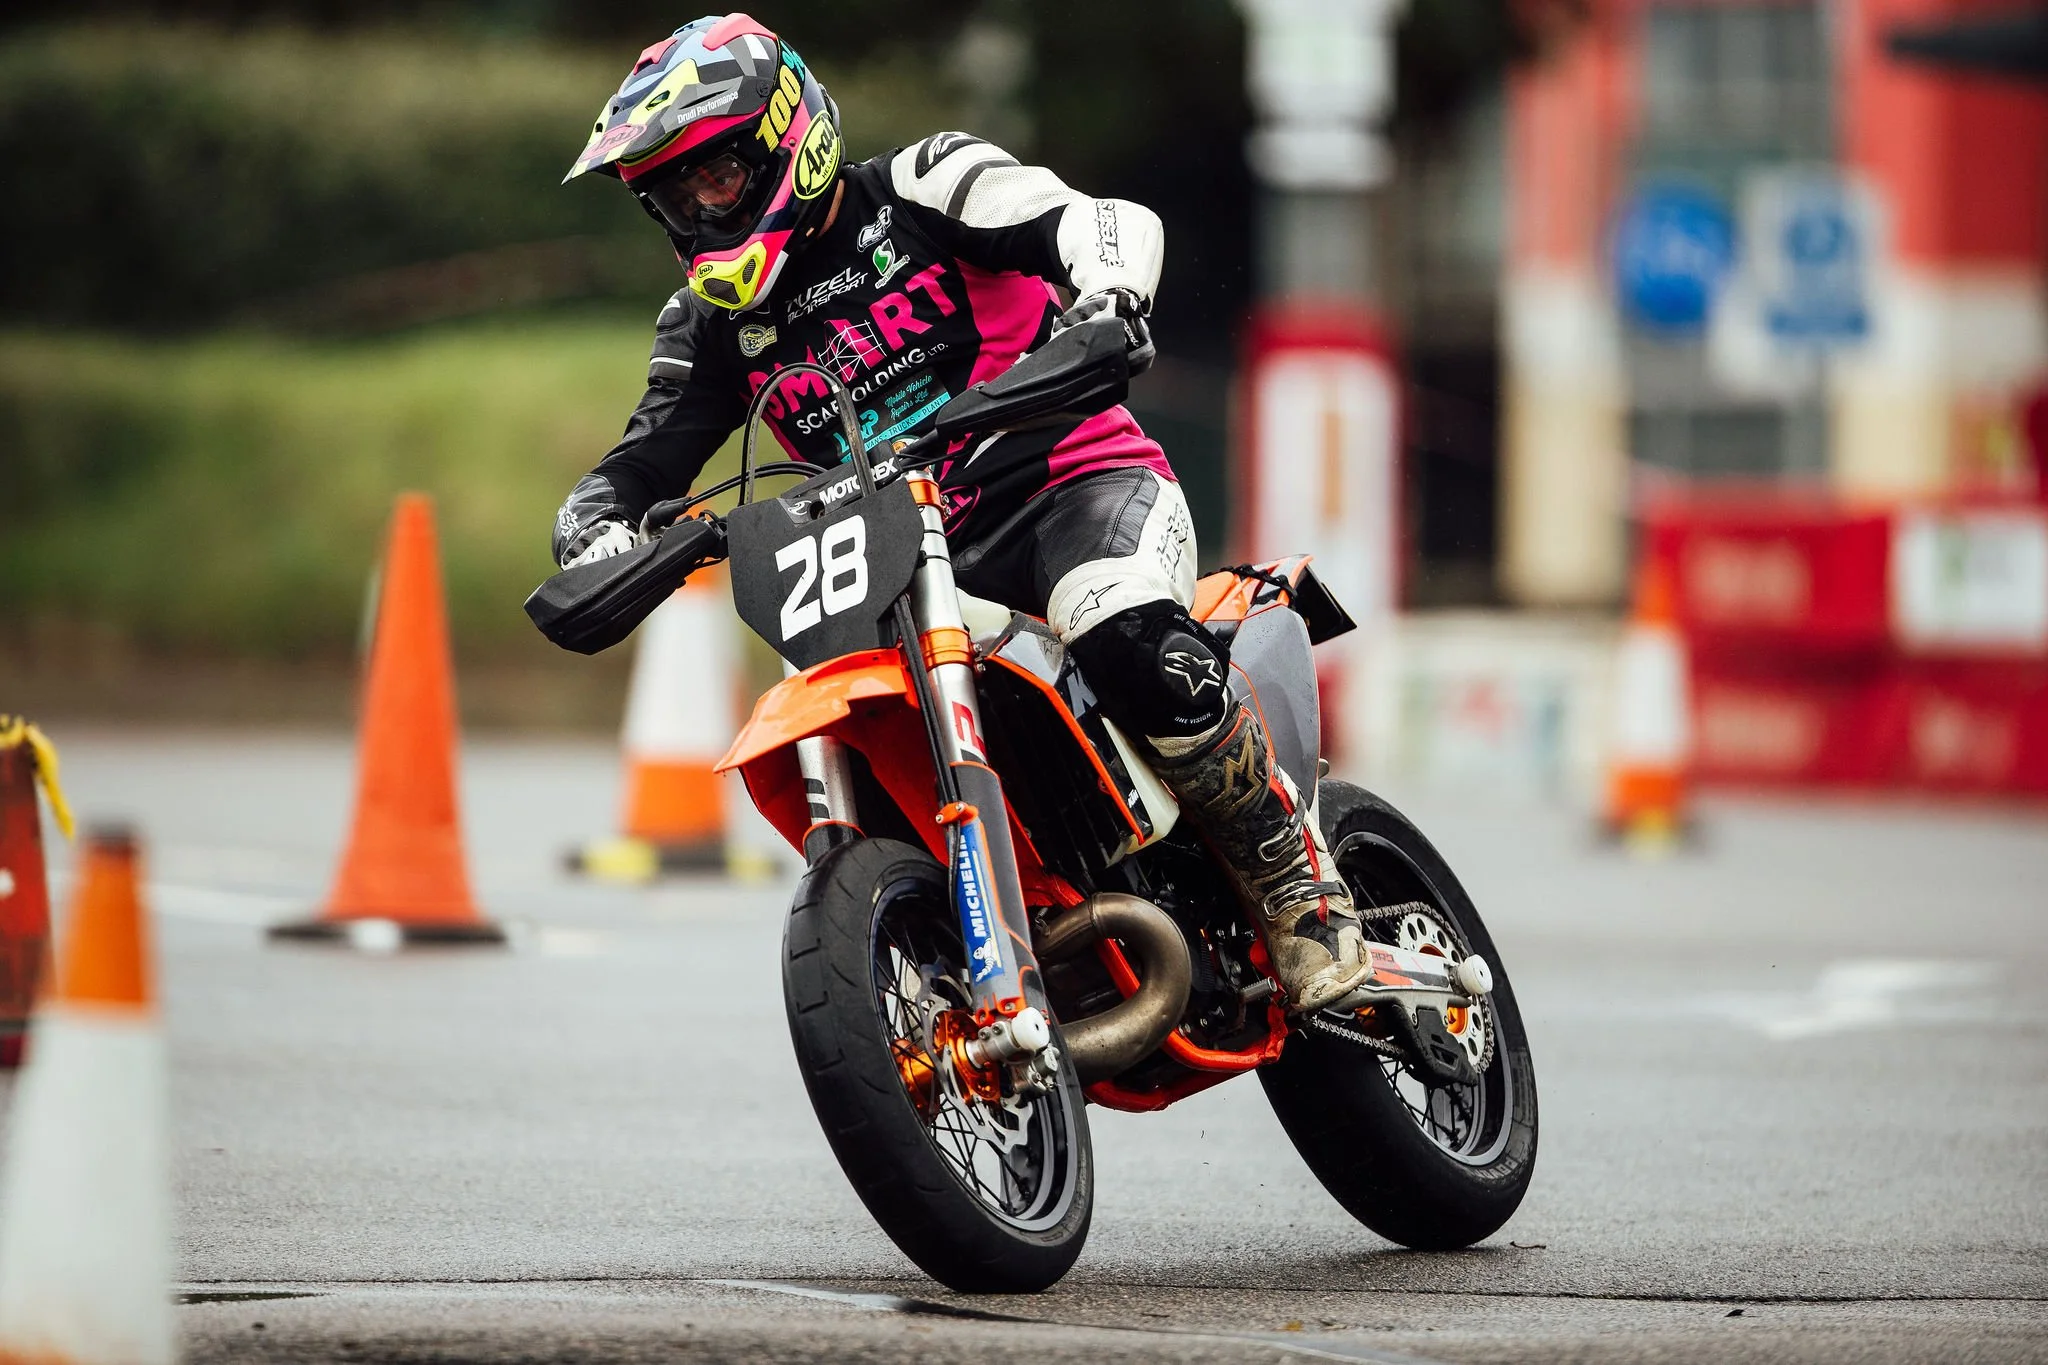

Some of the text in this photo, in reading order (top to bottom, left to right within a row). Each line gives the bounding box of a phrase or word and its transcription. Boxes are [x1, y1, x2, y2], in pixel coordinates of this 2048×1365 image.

[677, 89, 739, 124] Drudi Performance
[802, 120, 835, 194] Arai
[796, 348, 926, 435] SCAFOLDING
[927, 342, 949, 358] LTD.
[906, 373, 934, 394] Vehicle
[888, 417, 917, 437] TRUCKS
[922, 396, 943, 417] PLANT
[774, 514, 869, 642] 28
